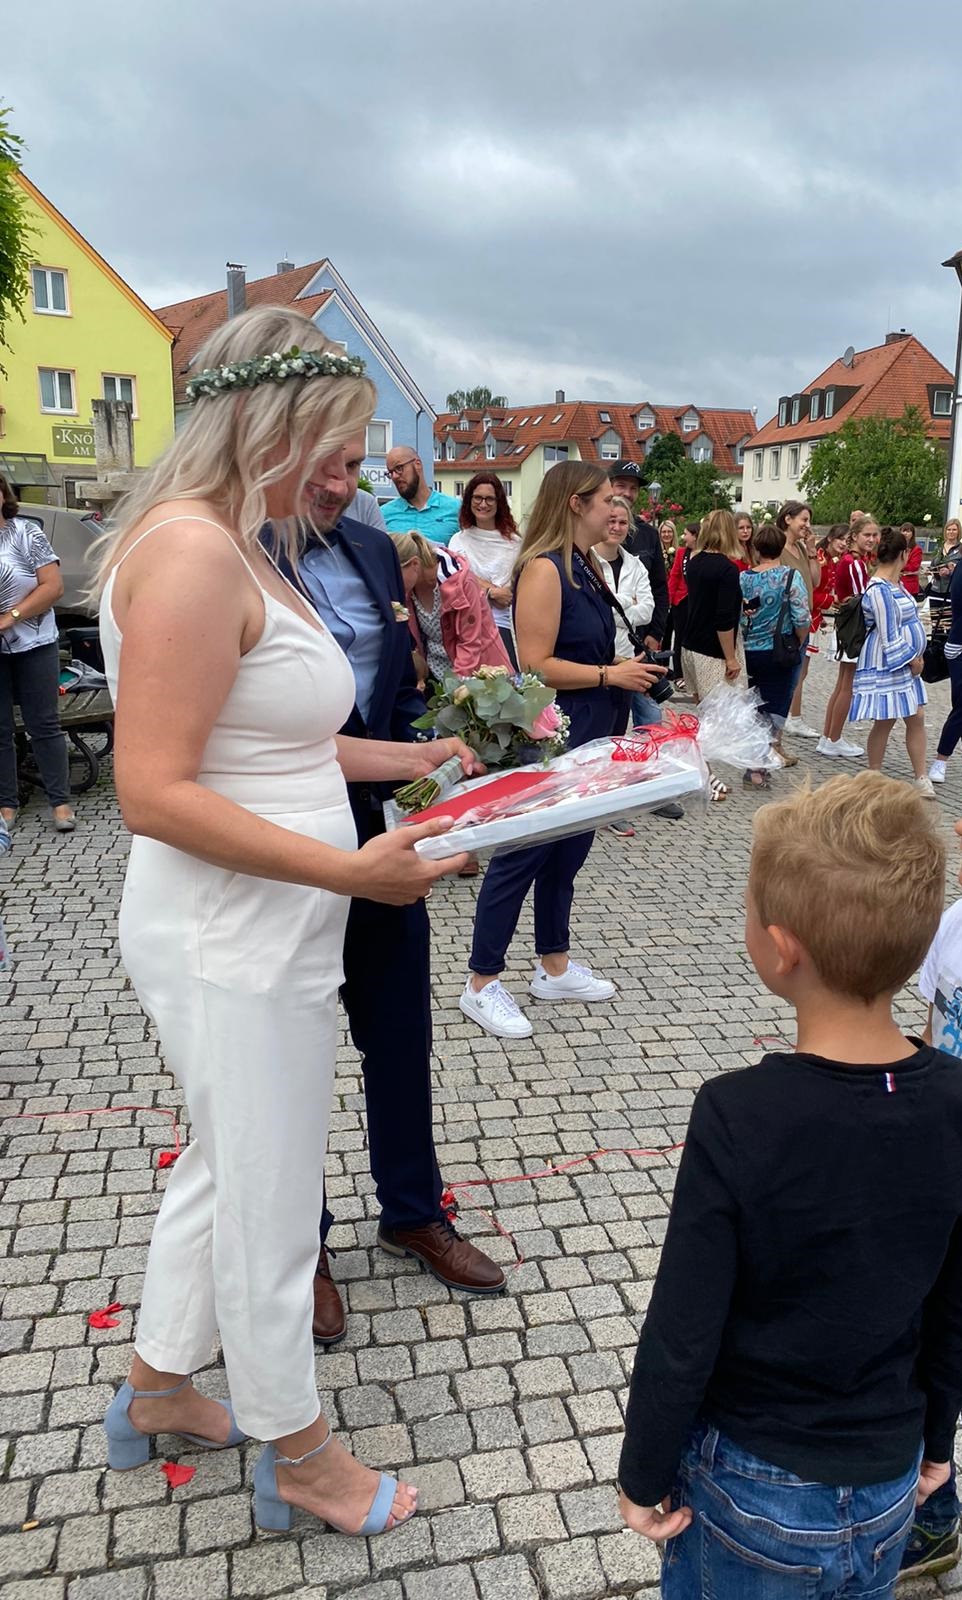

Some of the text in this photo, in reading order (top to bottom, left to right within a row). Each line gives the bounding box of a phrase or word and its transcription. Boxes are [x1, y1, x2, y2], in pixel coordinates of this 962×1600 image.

[60, 428, 96, 445] KNÖ
[72, 446, 90, 456] AM
[583, 565, 602, 590] DIGITAL
